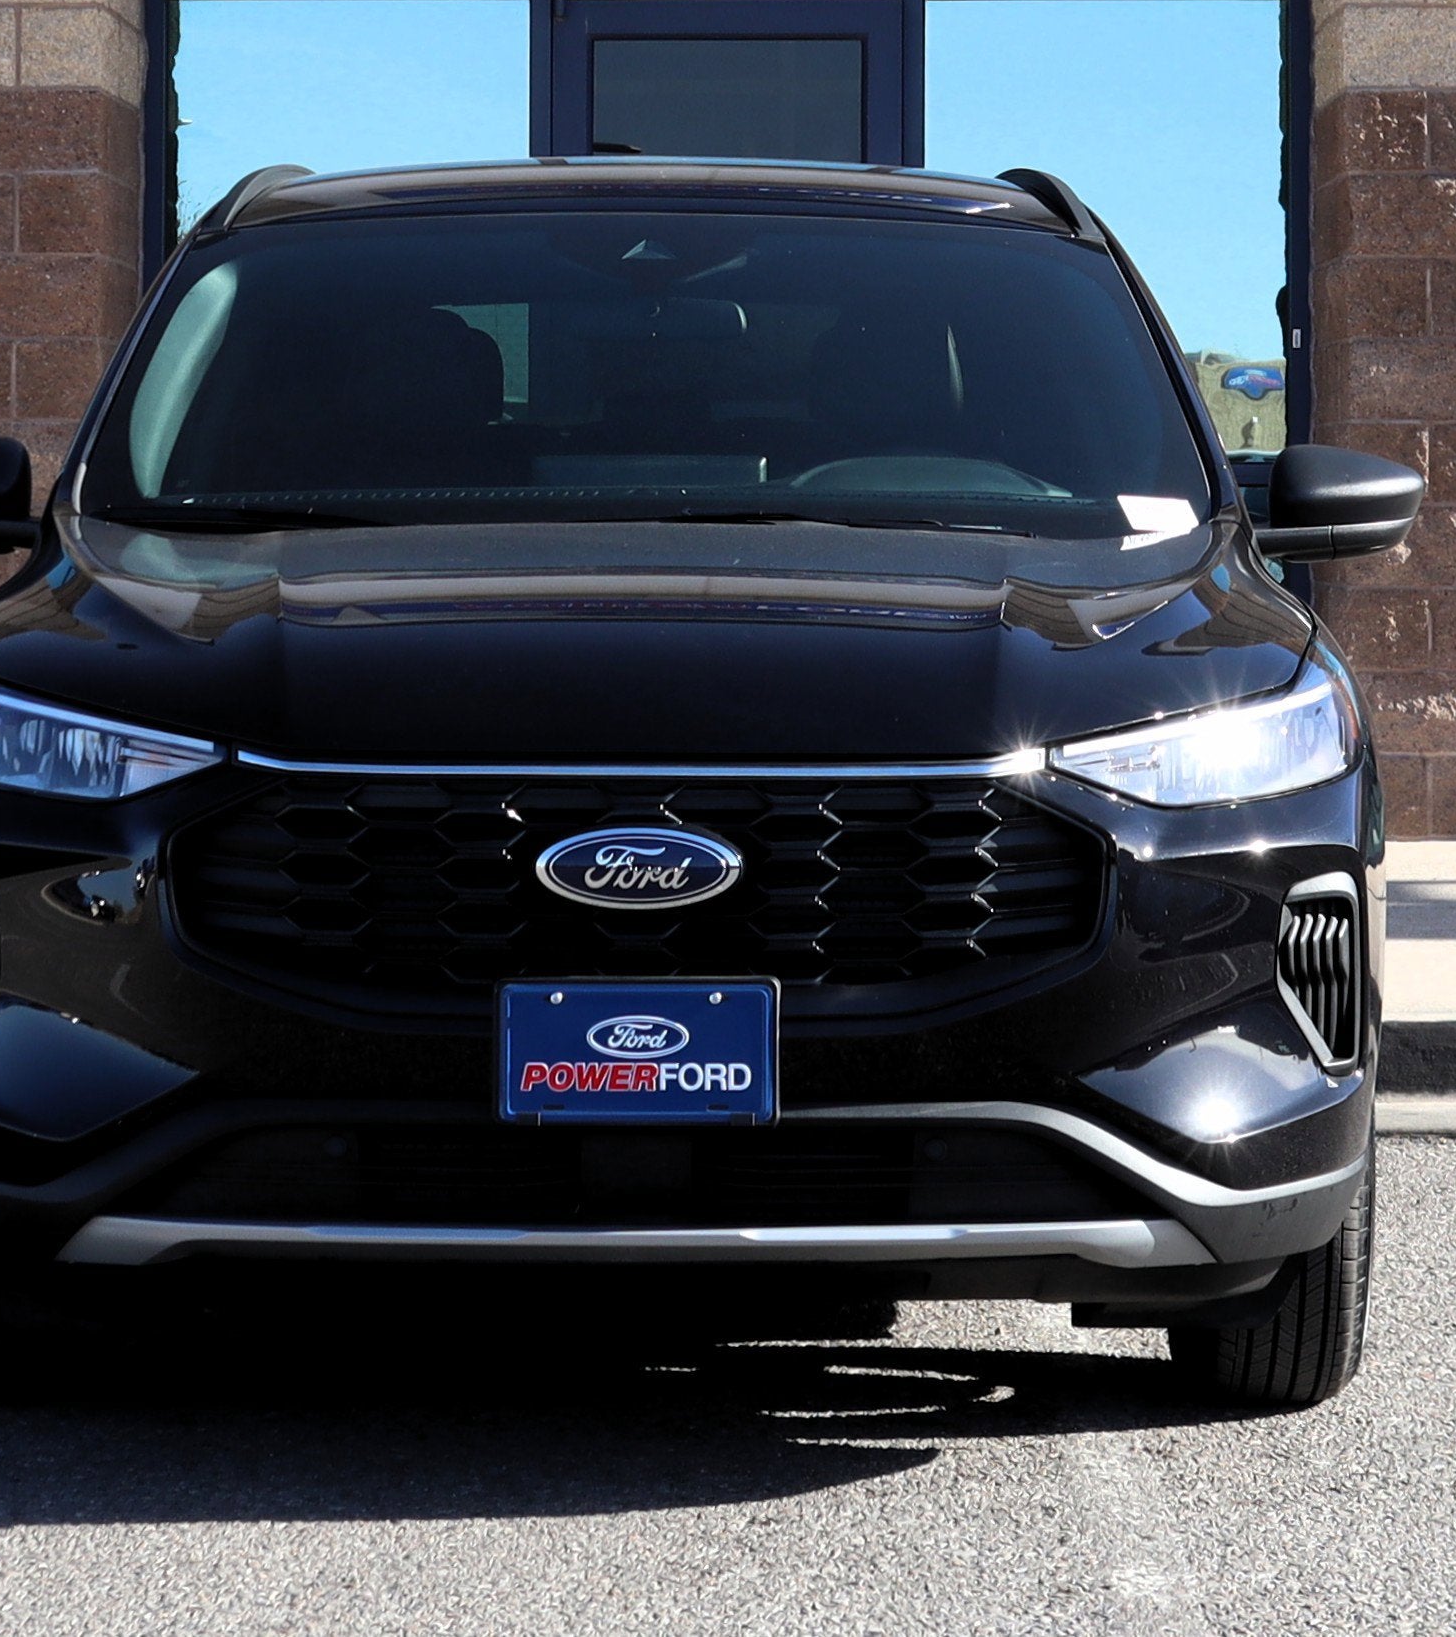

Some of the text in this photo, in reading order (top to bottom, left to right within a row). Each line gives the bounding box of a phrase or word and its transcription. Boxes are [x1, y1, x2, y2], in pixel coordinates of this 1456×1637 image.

[584, 845, 692, 889] Ford
[608, 1024, 667, 1049] Ford
[521, 1062, 752, 1092] POWERFORD
